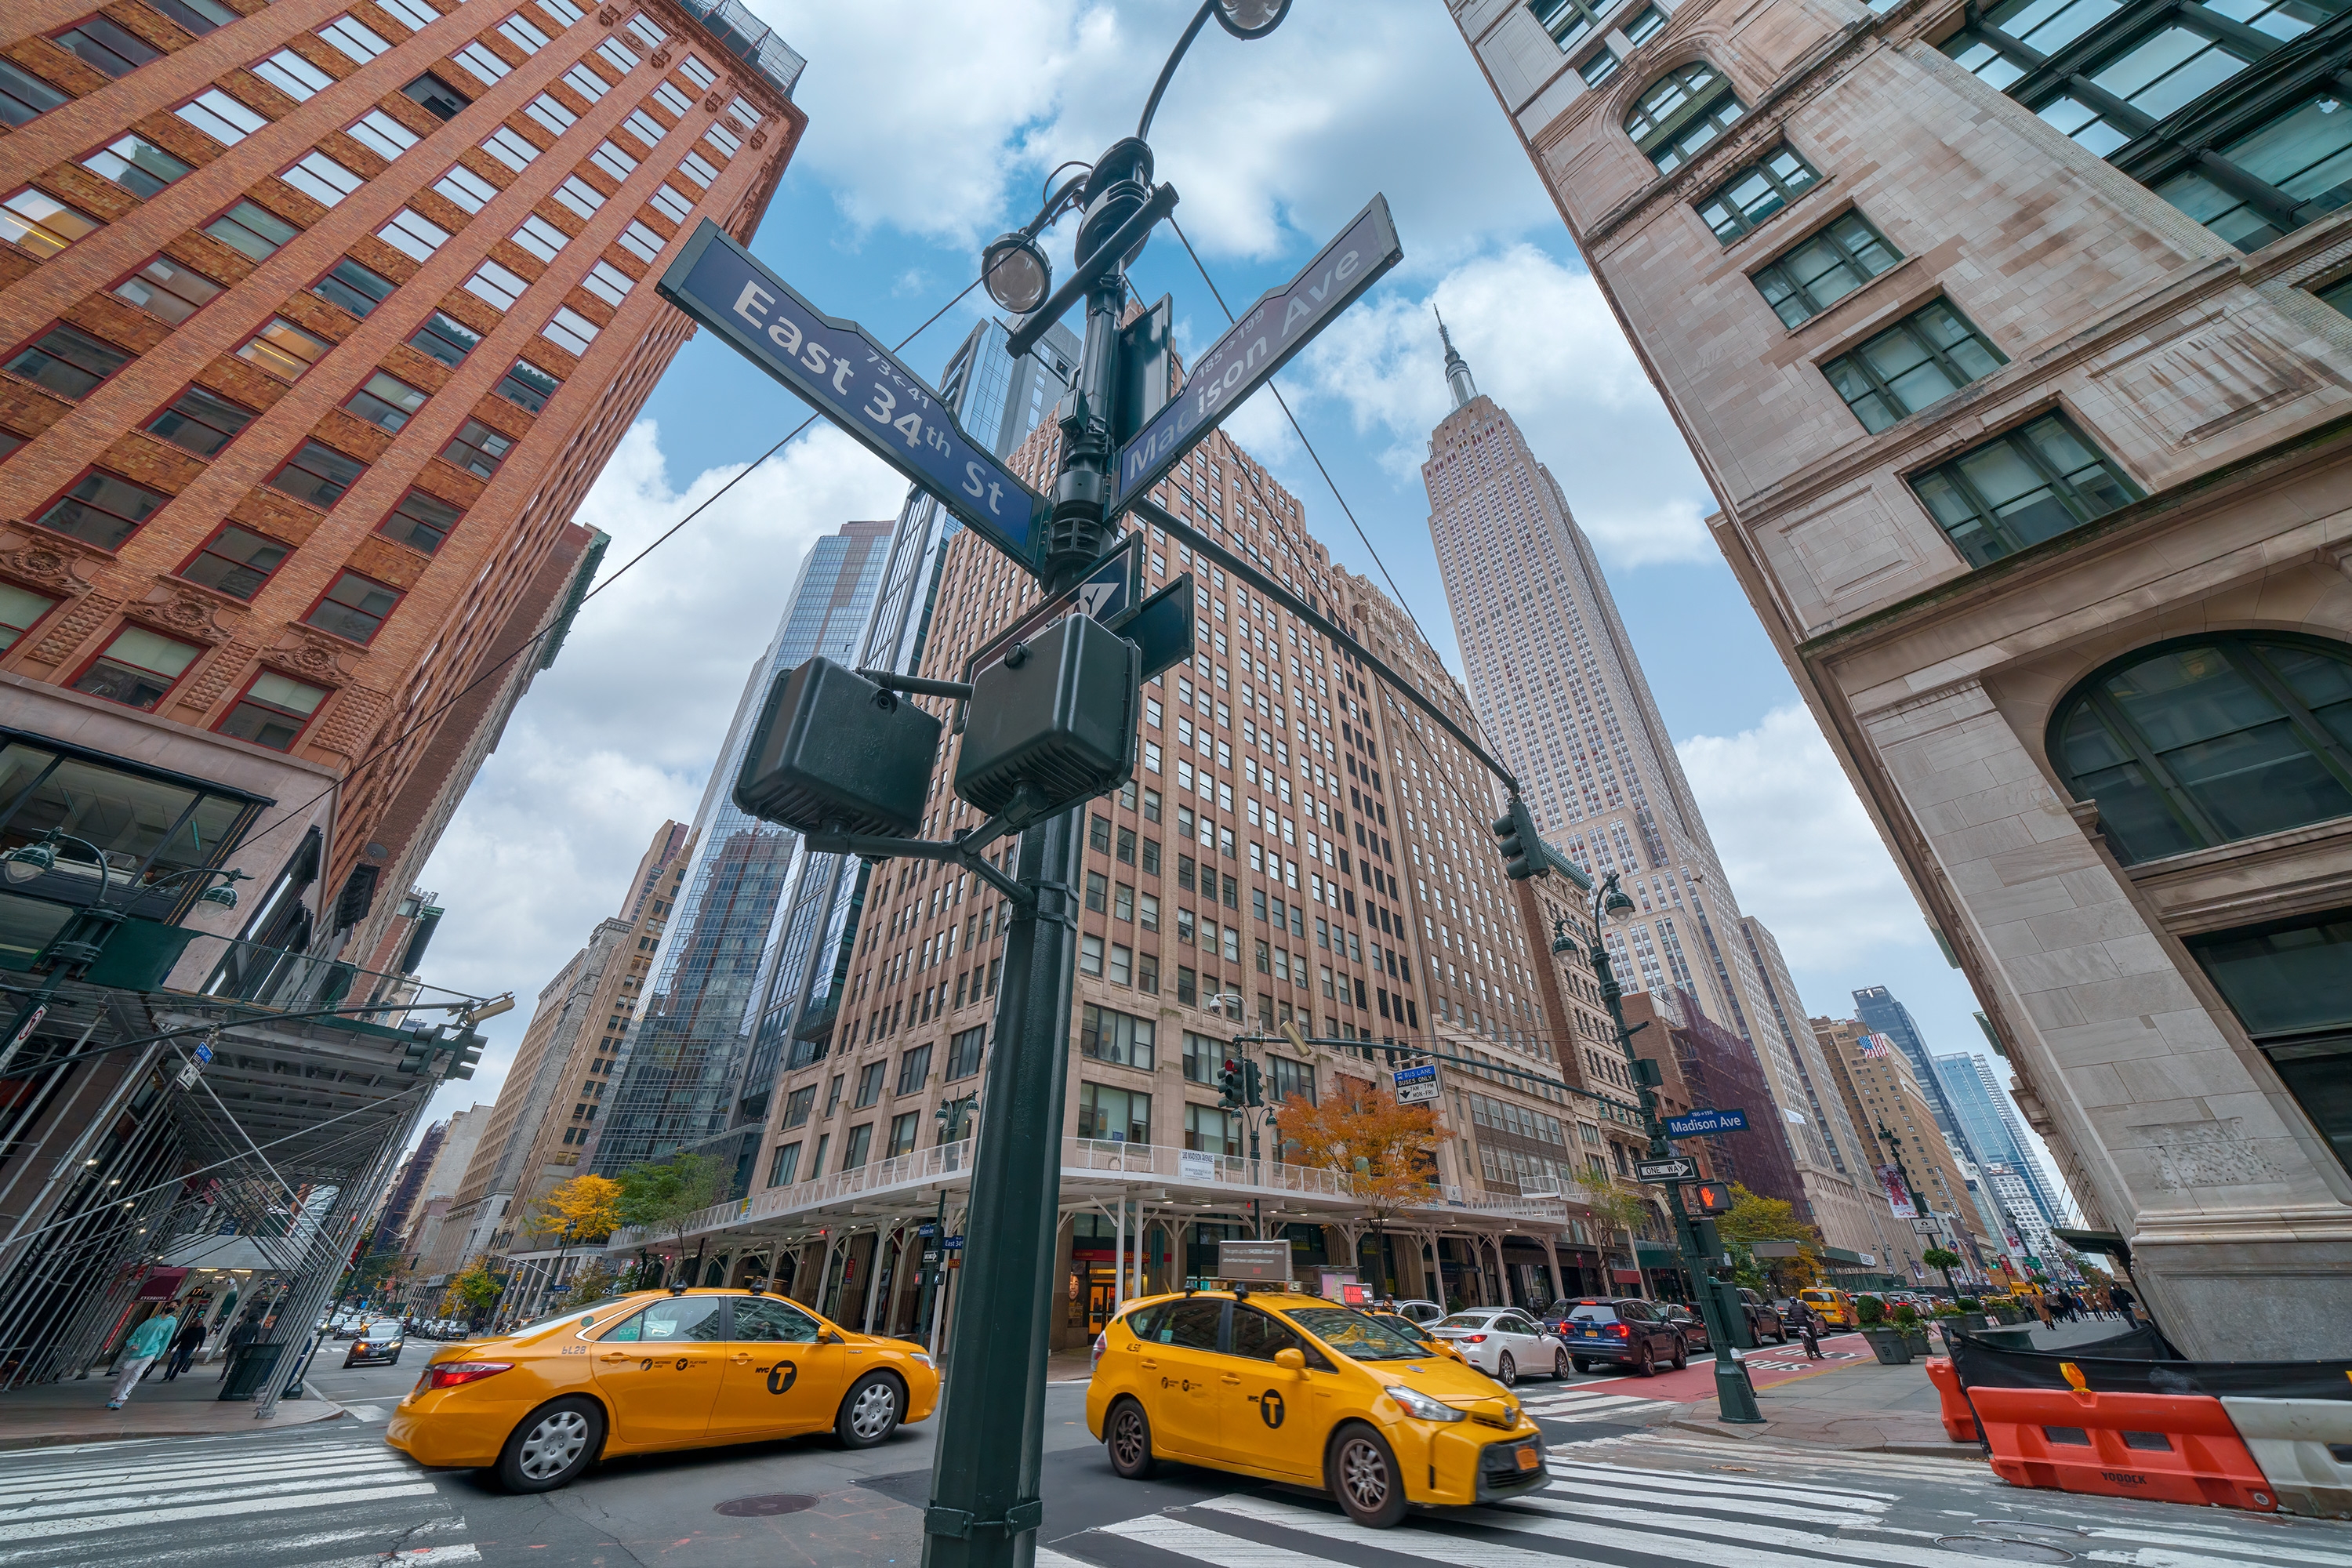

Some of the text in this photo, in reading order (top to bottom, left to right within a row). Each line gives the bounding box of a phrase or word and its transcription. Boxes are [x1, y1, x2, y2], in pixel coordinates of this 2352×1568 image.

[1198, 309, 1265, 379] 185 199
[1129, 249, 1359, 481] Madison Ave
[866, 349, 930, 409] 73 41
[733, 279, 1004, 515] East 34th St
[1866, 989, 1874, 998] 1
[1398, 1078, 1416, 1087] BUSES
[1671, 1116, 1742, 1134] Madison Ave
[1188, 1152, 1202, 1160] MADISON
[1202, 1153, 1214, 1163] AVENUE
[1667, 1164, 1683, 1173] WAY
[1746, 1359, 1814, 1372] BUS
[1247, 1395, 1281, 1424] NYC T
[2100, 1471, 2147, 1485] YODOCK
